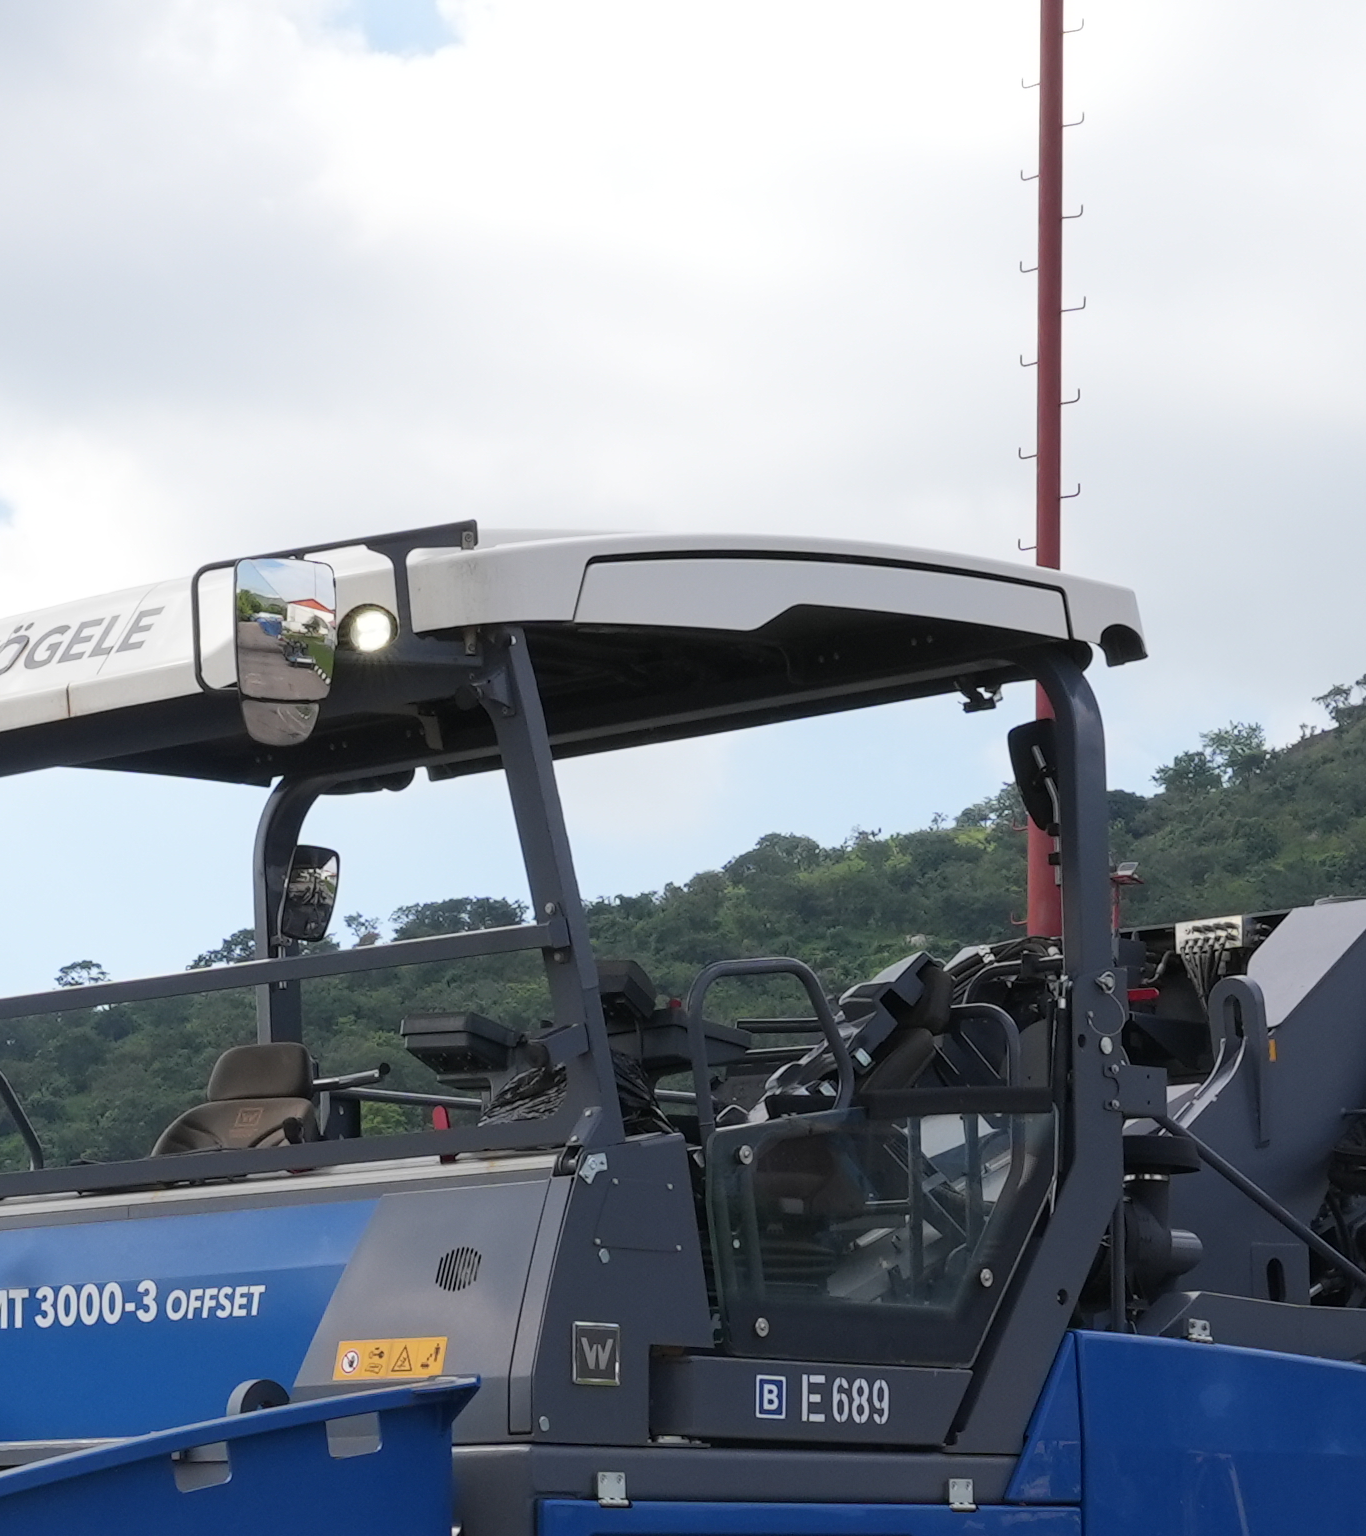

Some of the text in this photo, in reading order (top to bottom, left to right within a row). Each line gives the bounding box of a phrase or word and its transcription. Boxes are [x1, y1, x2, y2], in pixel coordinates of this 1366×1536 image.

[34, 1279, 158, 1329] 3000-3
[165, 1285, 266, 1321] OFFSET
[762, 1374, 890, 1425] B E 689
